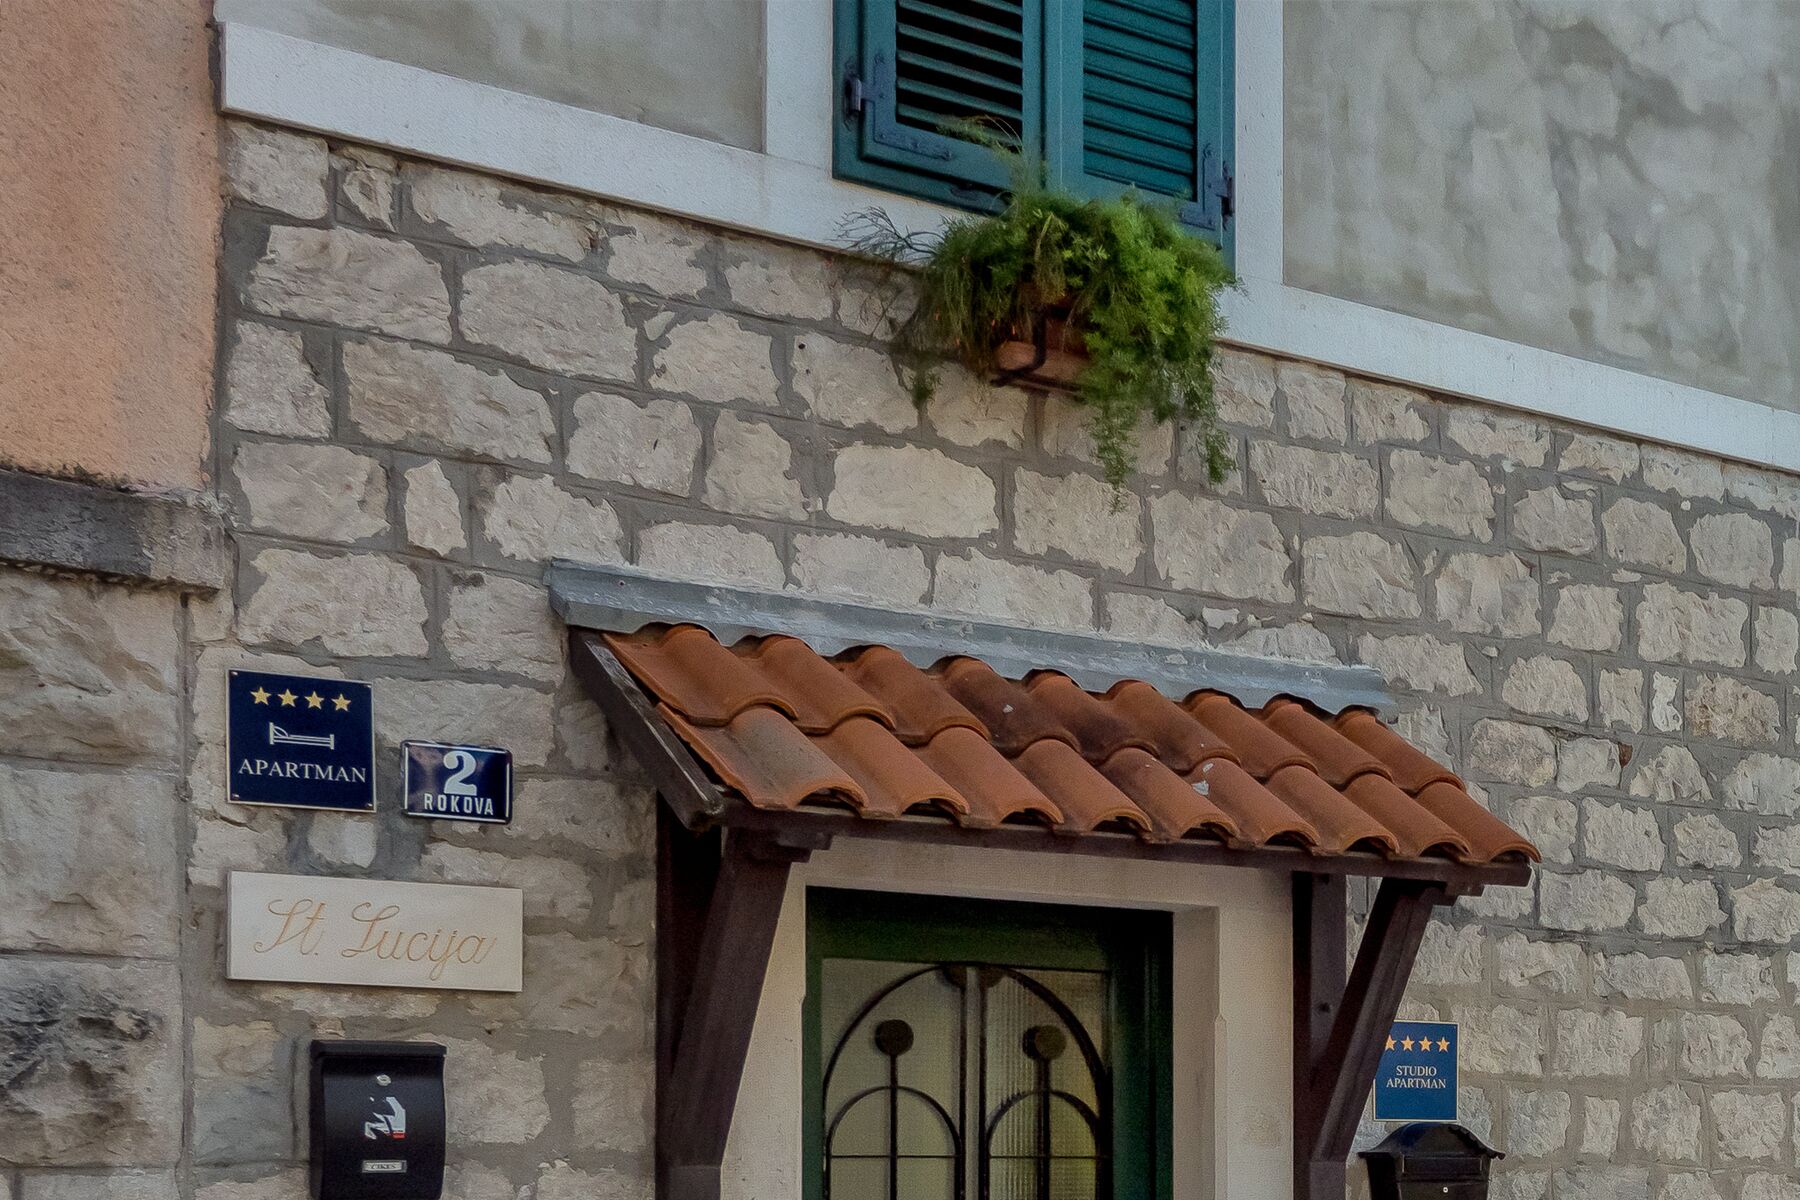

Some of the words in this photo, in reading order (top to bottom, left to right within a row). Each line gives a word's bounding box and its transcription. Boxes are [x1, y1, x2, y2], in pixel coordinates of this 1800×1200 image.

[238, 758, 366, 783] APARTMAN
[443, 750, 478, 796] 2
[424, 793, 494, 816] ROKOVA
[341, 901, 498, 981] Lucija
[1386, 1077, 1446, 1089] APARTMAN
[1396, 1065, 1437, 1077] STUDIO
